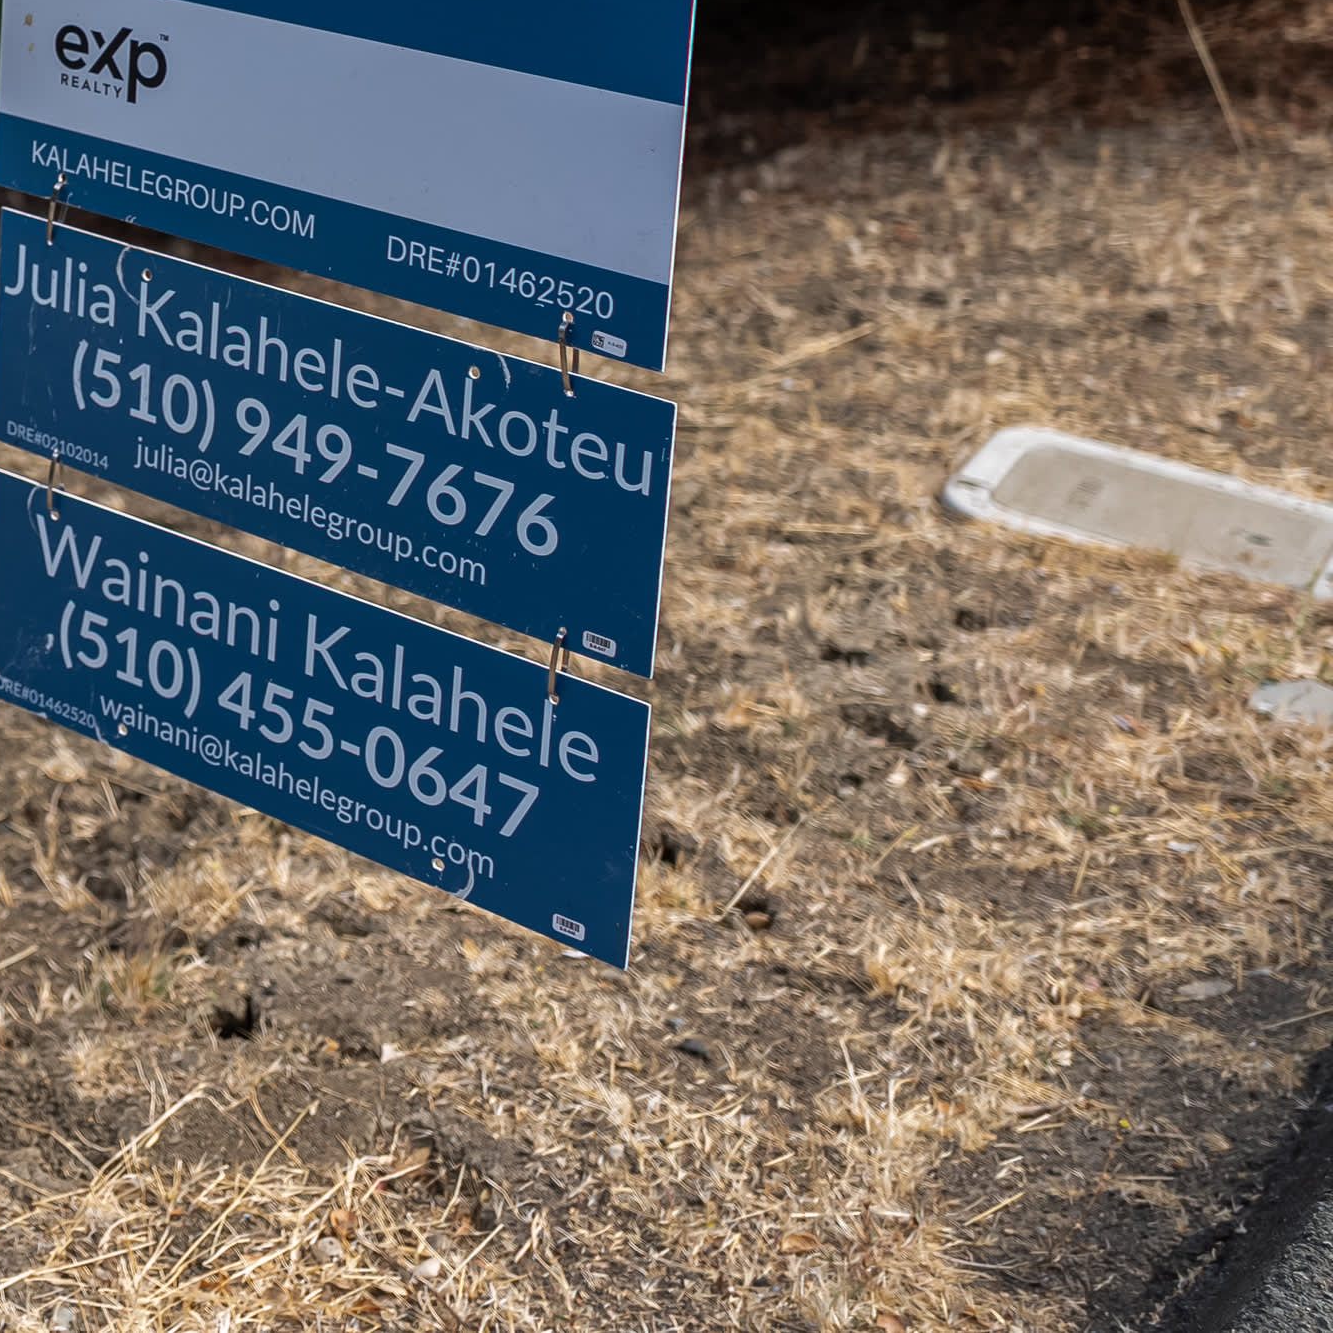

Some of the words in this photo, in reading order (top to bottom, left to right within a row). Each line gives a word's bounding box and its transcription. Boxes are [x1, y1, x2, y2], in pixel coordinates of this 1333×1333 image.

[60, 73, 123, 99] REALTY
[32, 140, 316, 239] KALAHELEGROUP.COM
[386, 235, 614, 319] DRE#01462520
[4, 244, 117, 327] Julia
[137, 279, 653, 496] Kalahele-Akoteu
[6, 420, 109, 470] DRE#02102014
[73, 339, 215, 453] (510)
[236, 397, 559, 556] 949-7676
[134, 436, 486, 586] julia@kalahelegroup.com
[36, 514, 280, 662] Wainani
[304, 613, 599, 782] Kalahele
[60, 599, 201, 719] (510)
[217, 671, 540, 838] 455-0647
[100, 695, 494, 879] wainani@kalahelegroup.com
